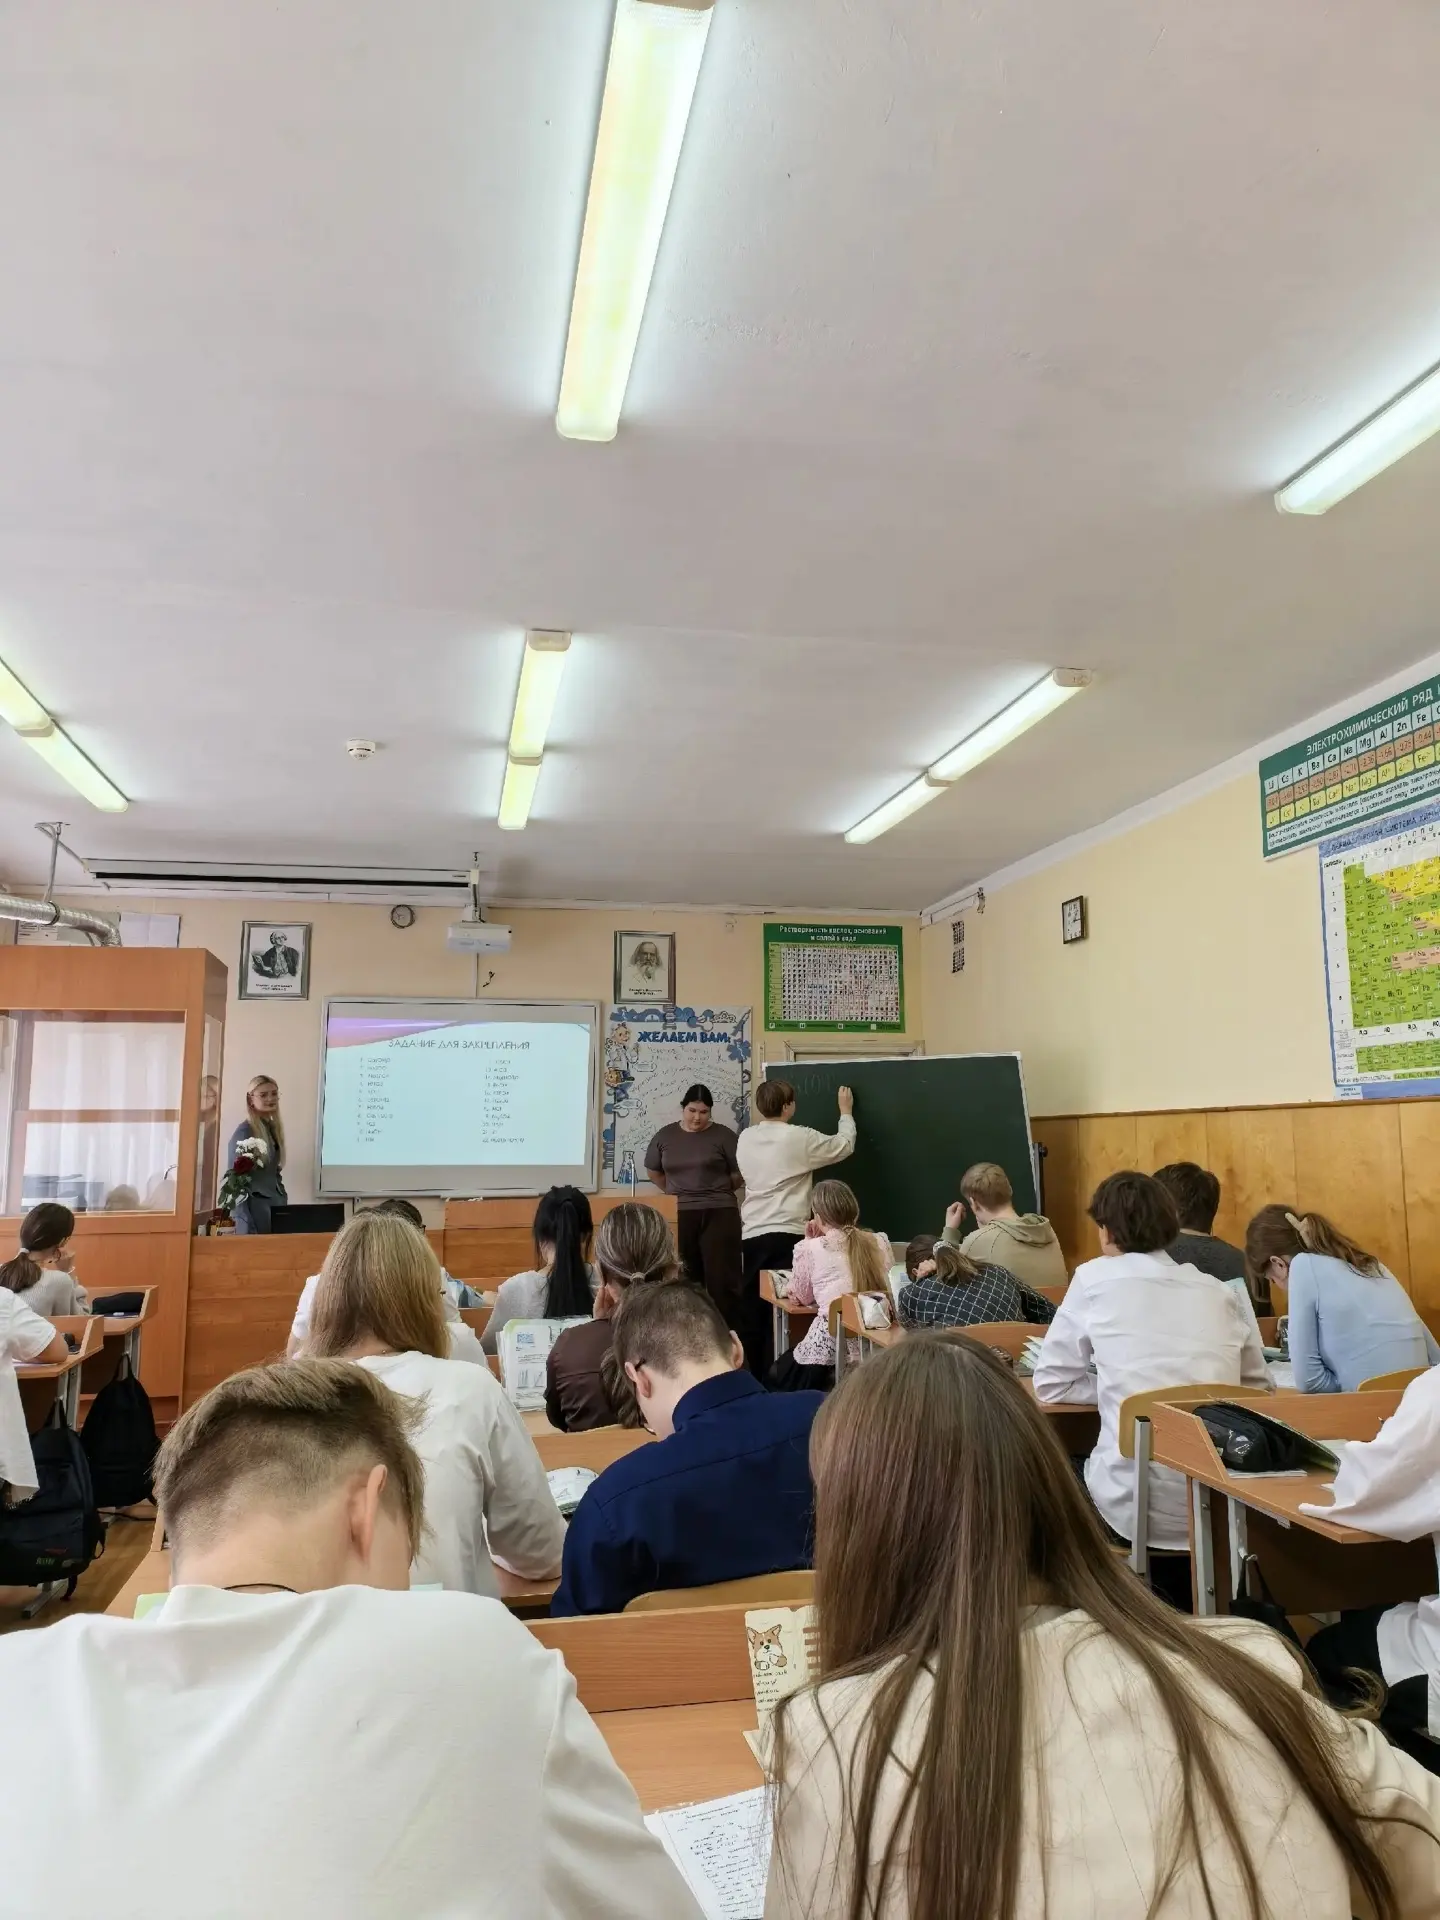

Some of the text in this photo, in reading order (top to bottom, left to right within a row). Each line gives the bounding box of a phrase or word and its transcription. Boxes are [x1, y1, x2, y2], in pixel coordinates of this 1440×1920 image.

[1306, 687, 1433, 756] ЭЛЕКТРОХИМИЧЕСКИЙ РЯД
[1327, 753, 1337, 763] Ca
[1359, 737, 1371, 751] Mg
[1380, 729, 1387, 740] Al
[1396, 721, 1408, 733] Zn
[1416, 713, 1427, 724] Fe
[779, 925, 828, 935] Растворимость
[637, 1031, 698, 1043] ЖЕЛАЕМ
[388, 1039, 531, 1051] ЗАДАНИЕ ДЛЯ ЗАКРЕПЛЕНИЯ
